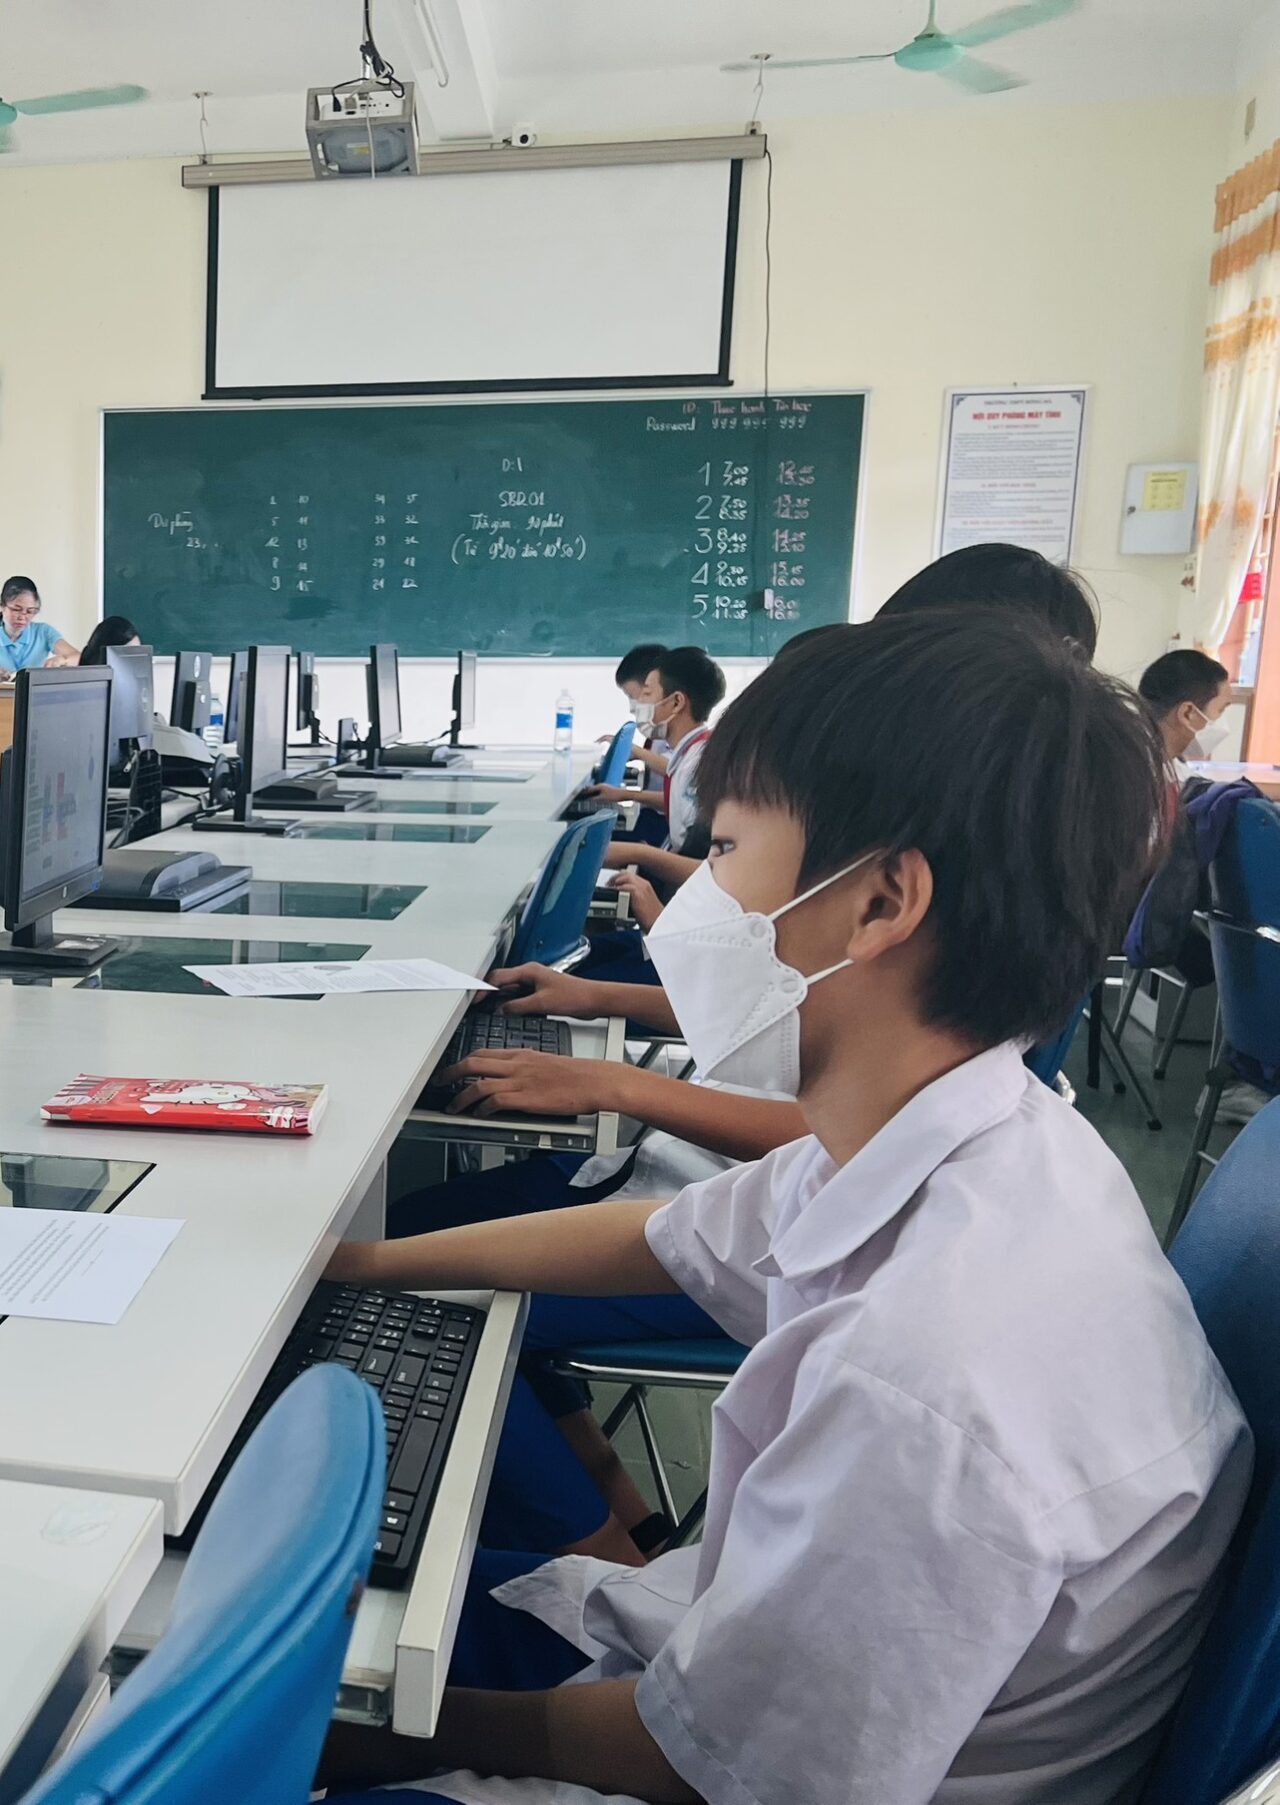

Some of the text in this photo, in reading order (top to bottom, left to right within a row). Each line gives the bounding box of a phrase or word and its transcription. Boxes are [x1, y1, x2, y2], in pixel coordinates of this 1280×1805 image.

[698, 462, 711, 486] 1
[694, 494, 713, 520] 2
[695, 528, 713, 553] 3
[691, 562, 709, 585] 4
[692, 594, 710, 618] 5
